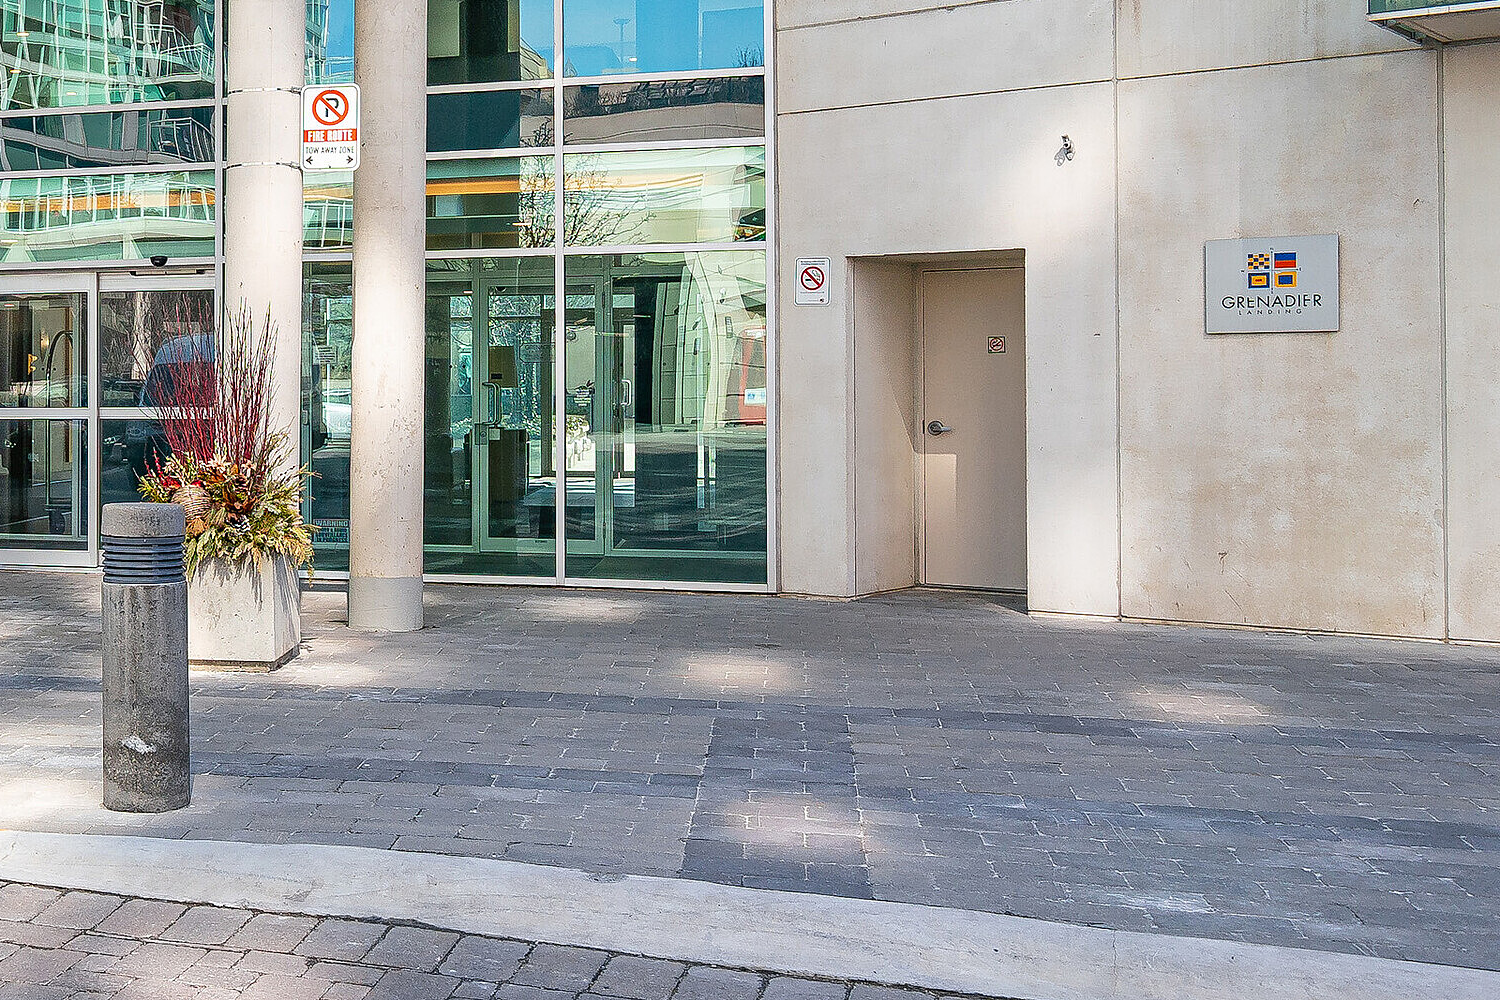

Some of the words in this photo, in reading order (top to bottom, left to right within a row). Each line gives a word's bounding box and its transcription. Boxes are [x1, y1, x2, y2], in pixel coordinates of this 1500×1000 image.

[307, 130, 325, 142] FIRE
[327, 129, 353, 141] ROUTE
[305, 146, 319, 154] TOW
[321, 146, 337, 154] AWAY
[339, 145, 354, 154] ZONE
[1221, 294, 1322, 309] GRENADIER
[1238, 308, 1302, 316] LANDING
